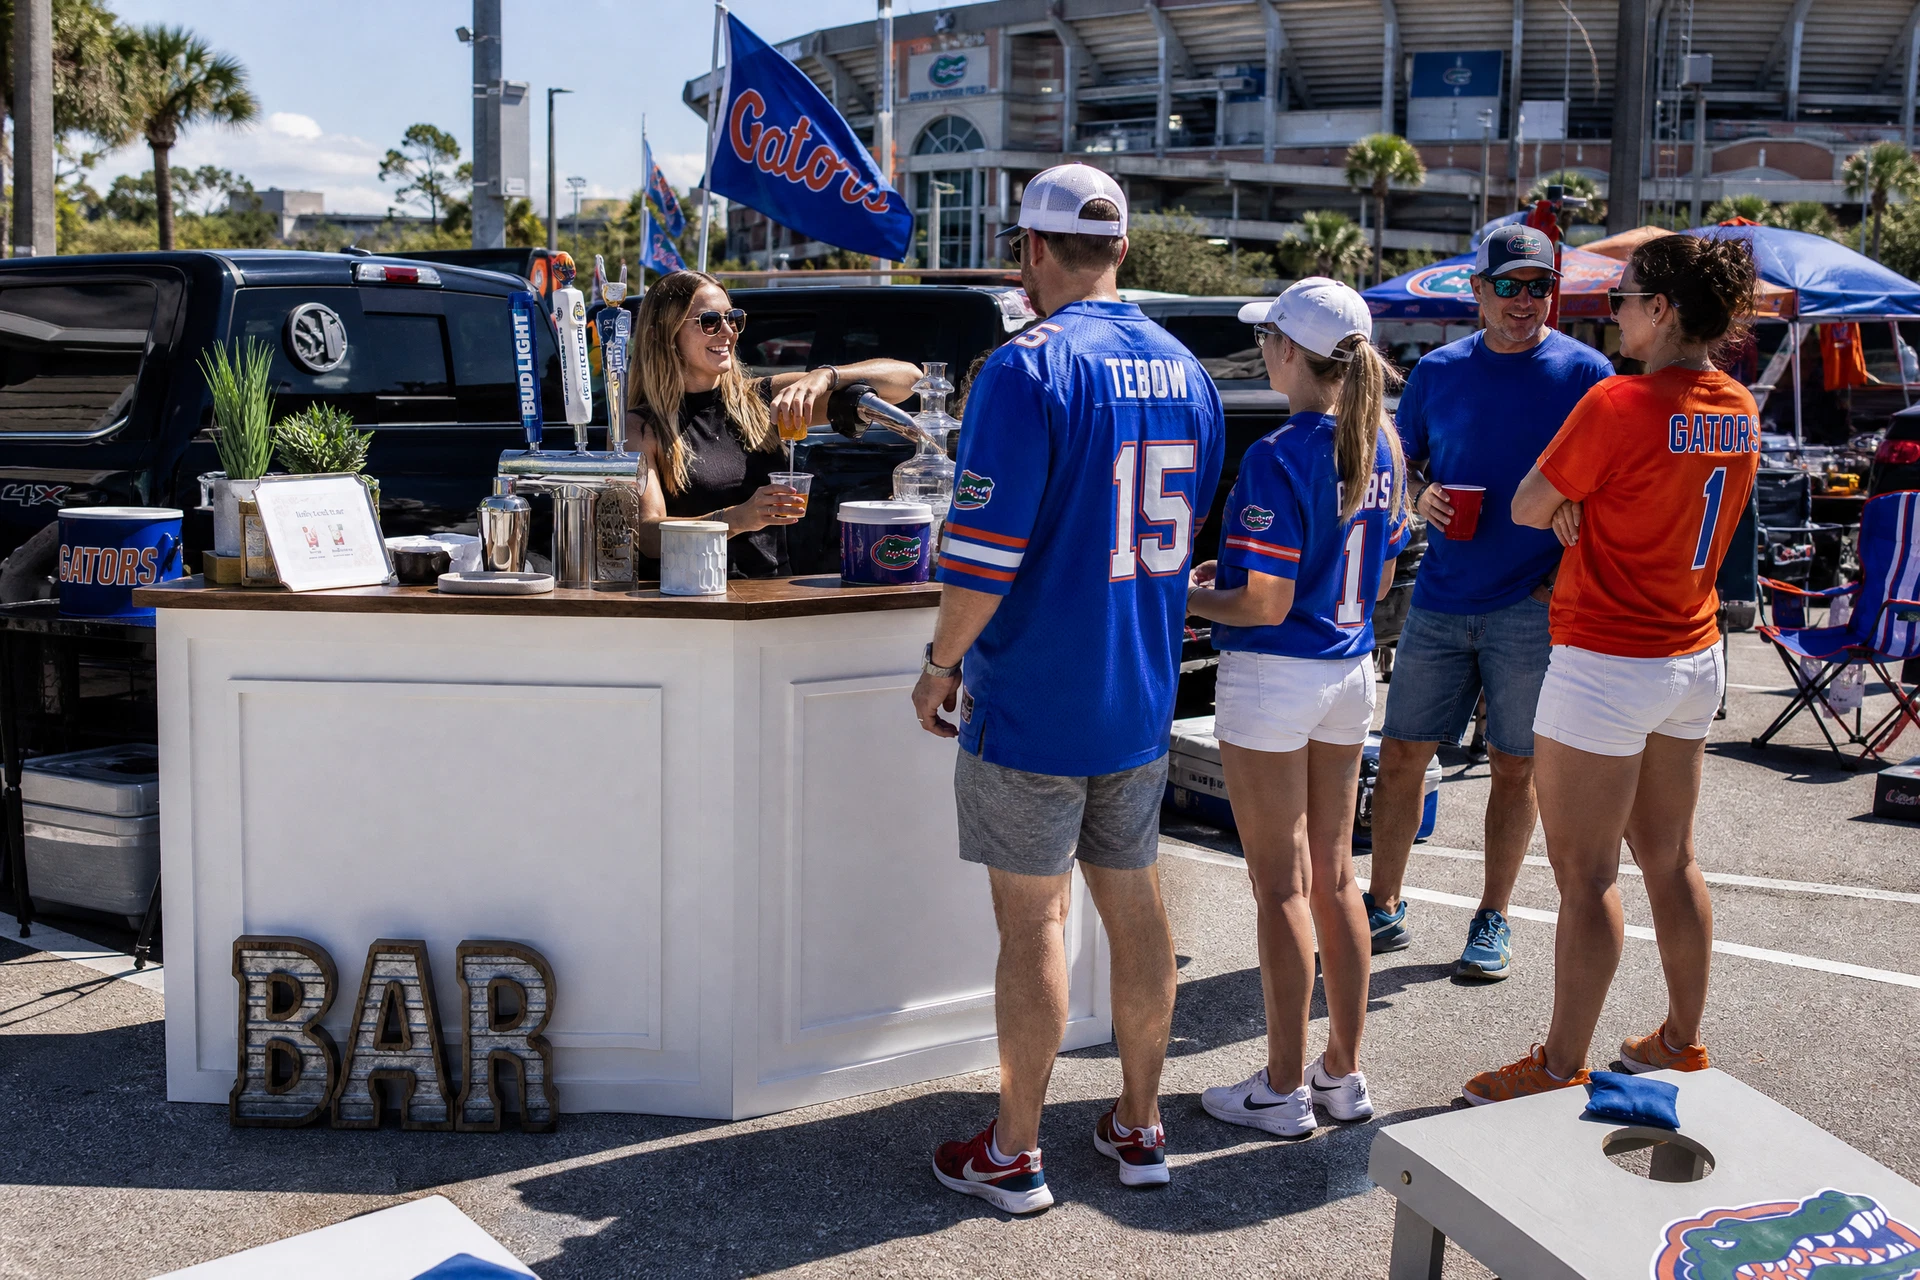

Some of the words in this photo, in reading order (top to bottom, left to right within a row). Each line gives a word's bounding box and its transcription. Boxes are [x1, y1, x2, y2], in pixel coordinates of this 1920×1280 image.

[729, 88, 890, 213] Gators
[513, 313, 535, 371] LIGHT
[1003, 323, 1063, 349] 5
[519, 373, 537, 416] BUD
[1105, 358, 1187, 399] TEBOW
[1669, 414, 1759, 454] GATORS
[1, 484, 70, 507] 4X
[1109, 440, 1198, 582] 15
[1337, 472, 1391, 516] BS
[1691, 467, 1727, 570] 1
[59, 544, 159, 586] GATORS
[1335, 520, 1367, 628] 1
[229, 935, 559, 1133] BAR
